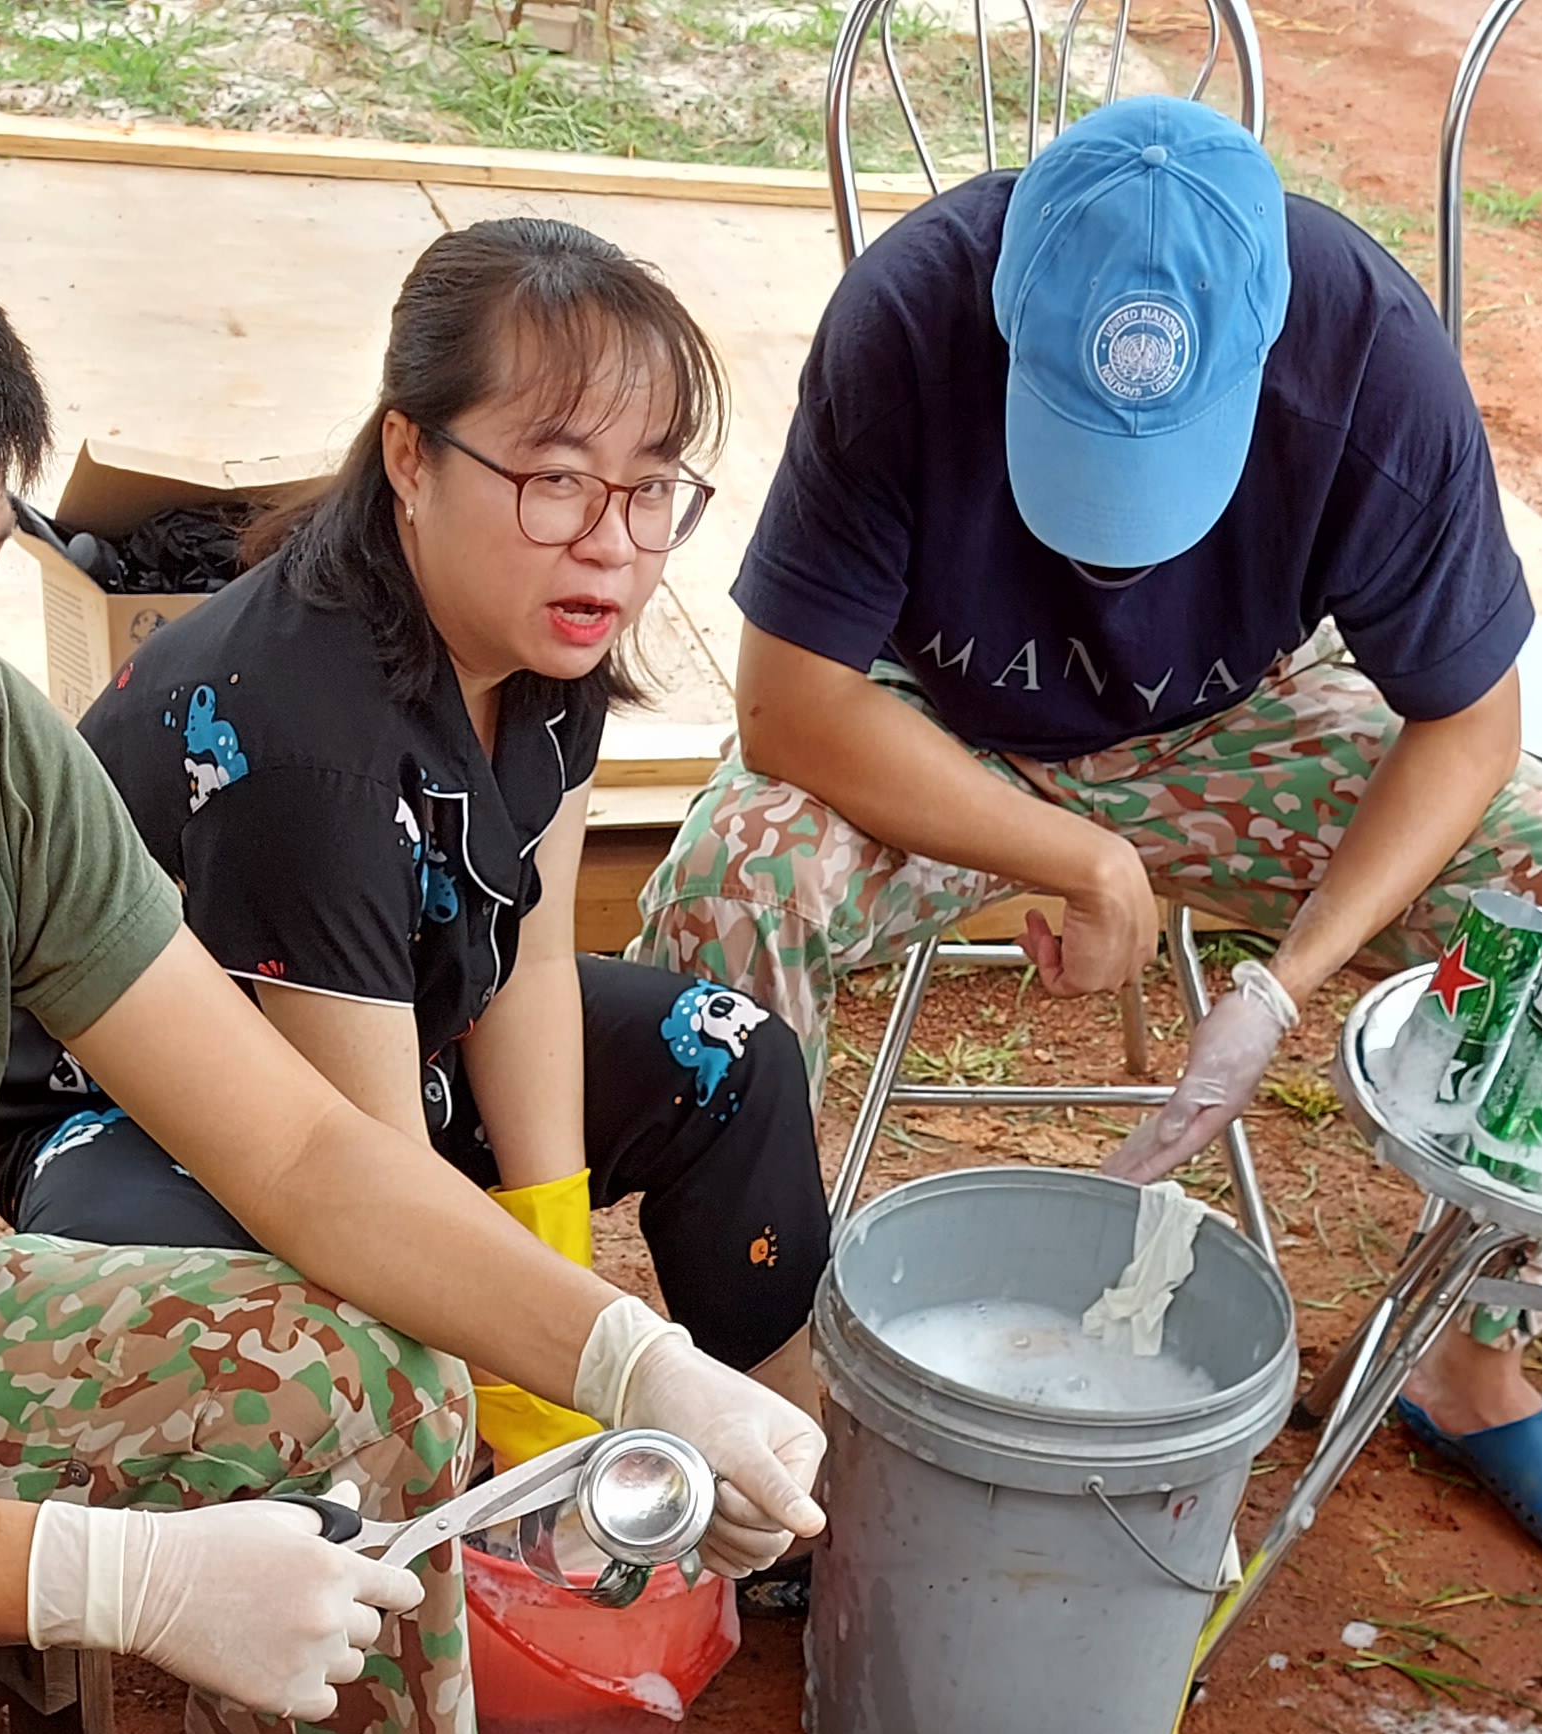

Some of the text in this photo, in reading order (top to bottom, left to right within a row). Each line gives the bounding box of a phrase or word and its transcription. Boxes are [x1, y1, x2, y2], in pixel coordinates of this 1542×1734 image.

[1104, 308, 1183, 341] UNITED NATIONS
[1099, 363, 1143, 398] NATIONS
